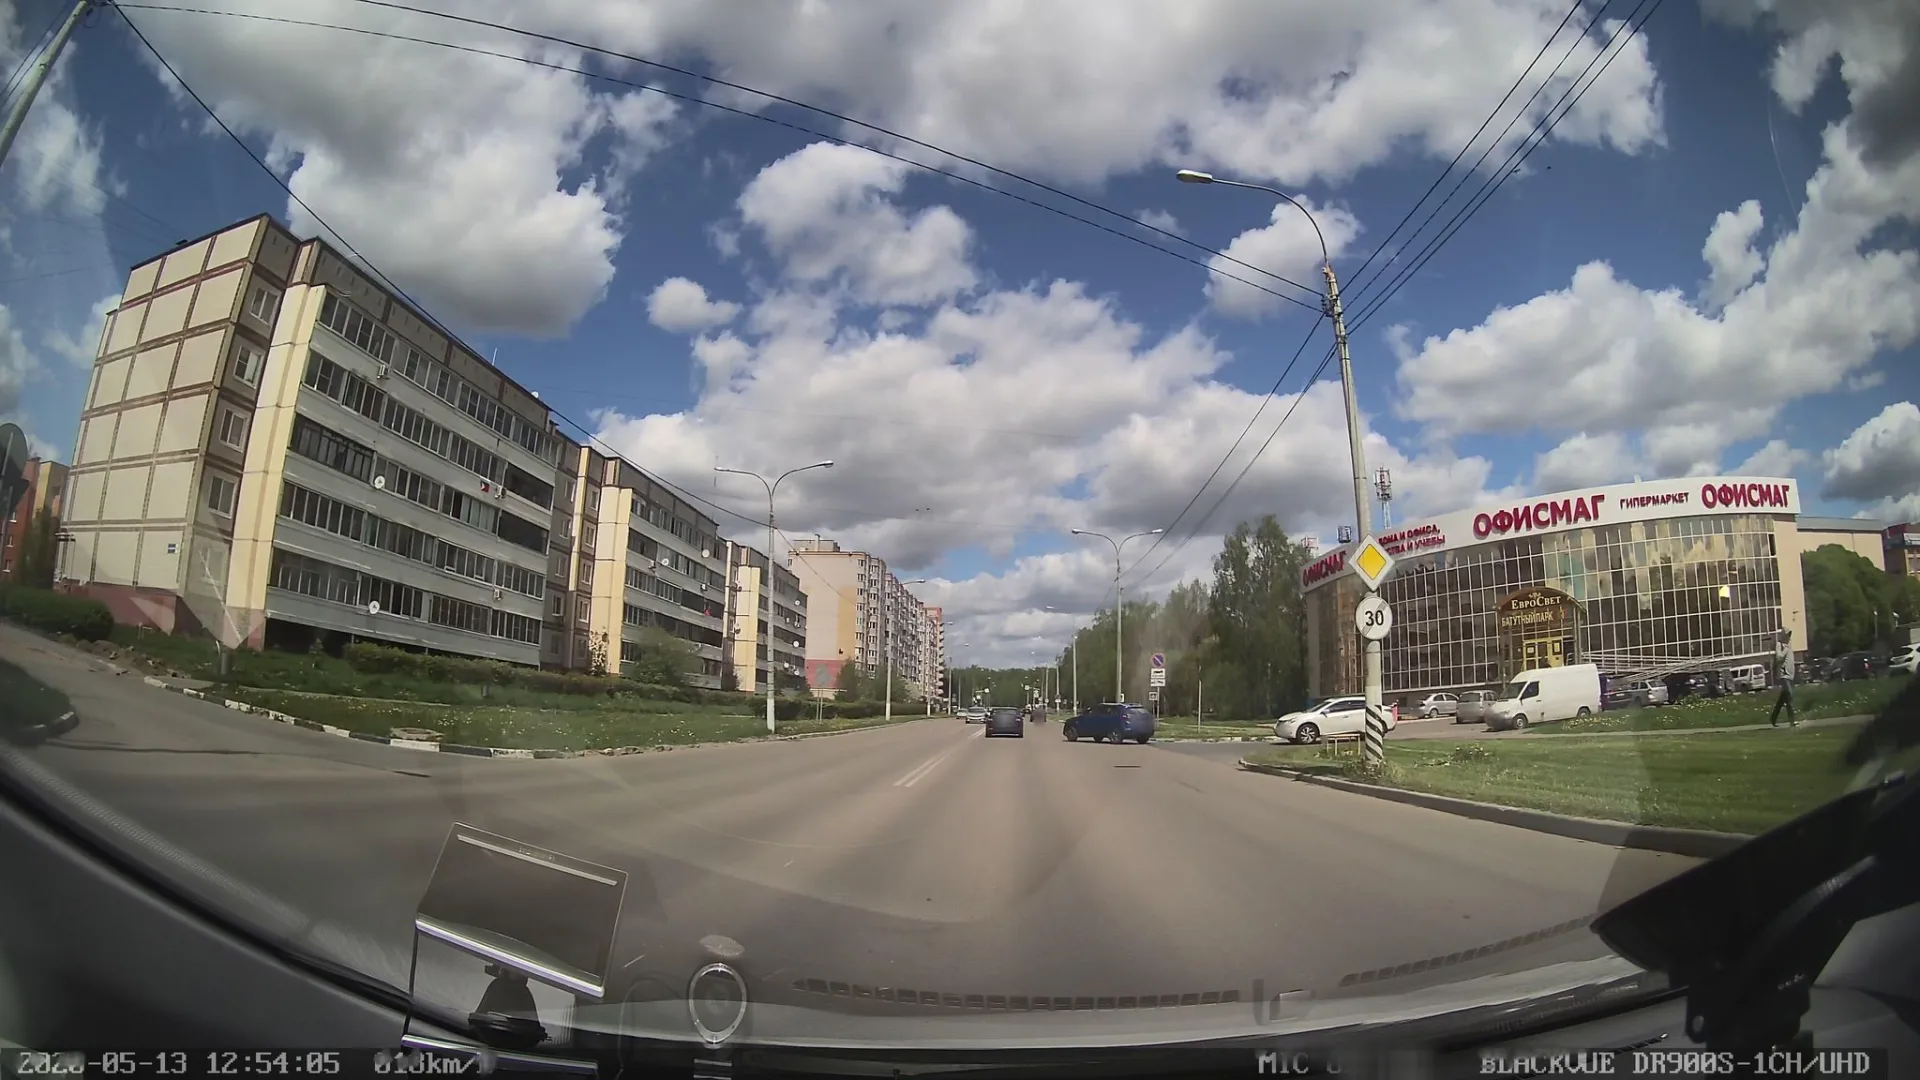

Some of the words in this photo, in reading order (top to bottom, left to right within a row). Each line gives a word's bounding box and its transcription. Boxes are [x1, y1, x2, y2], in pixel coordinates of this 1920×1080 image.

[1620, 492, 1690, 510] ГИПЕРМАРКЕТ
[1701, 483, 1789, 509] ОФИСМАГ
[1473, 494, 1605, 537] ОФИСМАГ
[1399, 531, 1405, 541] И
[1406, 524, 1441, 538] ОФИСА,
[1407, 542, 1413, 551] И
[1365, 610, 1384, 627] 30
